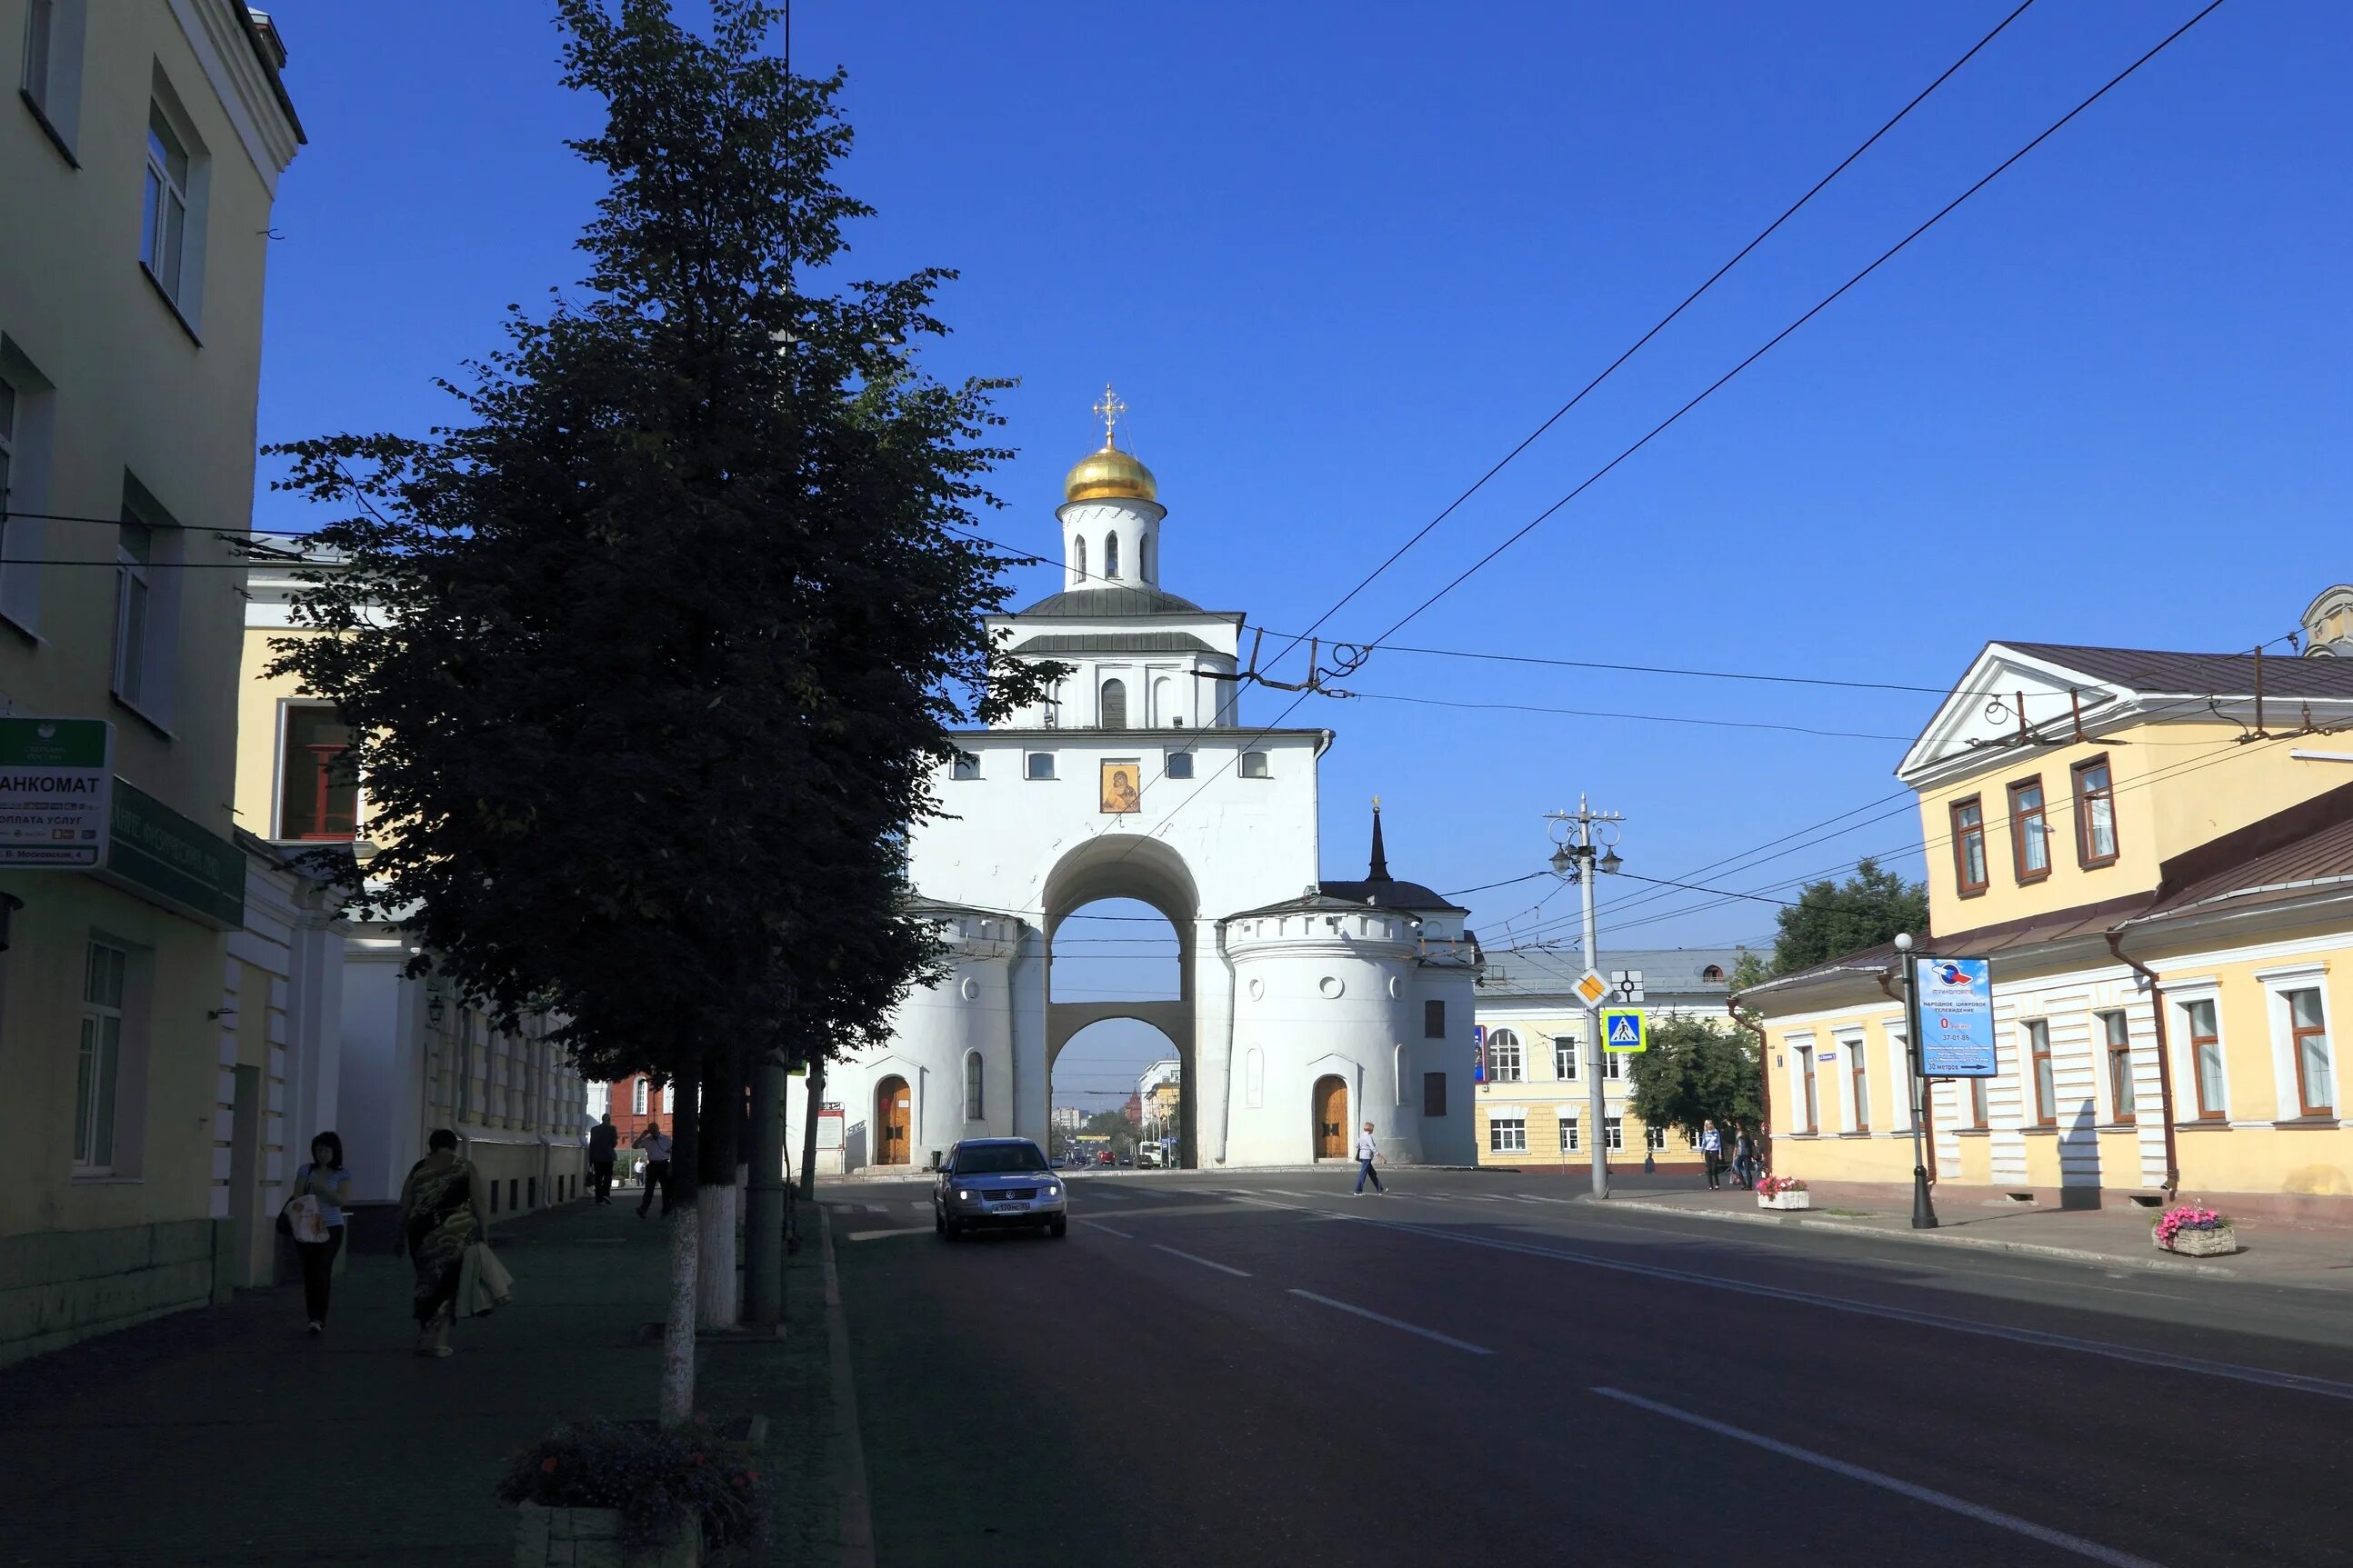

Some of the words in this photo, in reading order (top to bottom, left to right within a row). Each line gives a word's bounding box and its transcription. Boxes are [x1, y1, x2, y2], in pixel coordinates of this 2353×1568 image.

[0, 815, 44, 824] ОПЛАТА
[47, 816, 83, 825] УСЛУГ
[1941, 1018, 1948, 1028] 0
